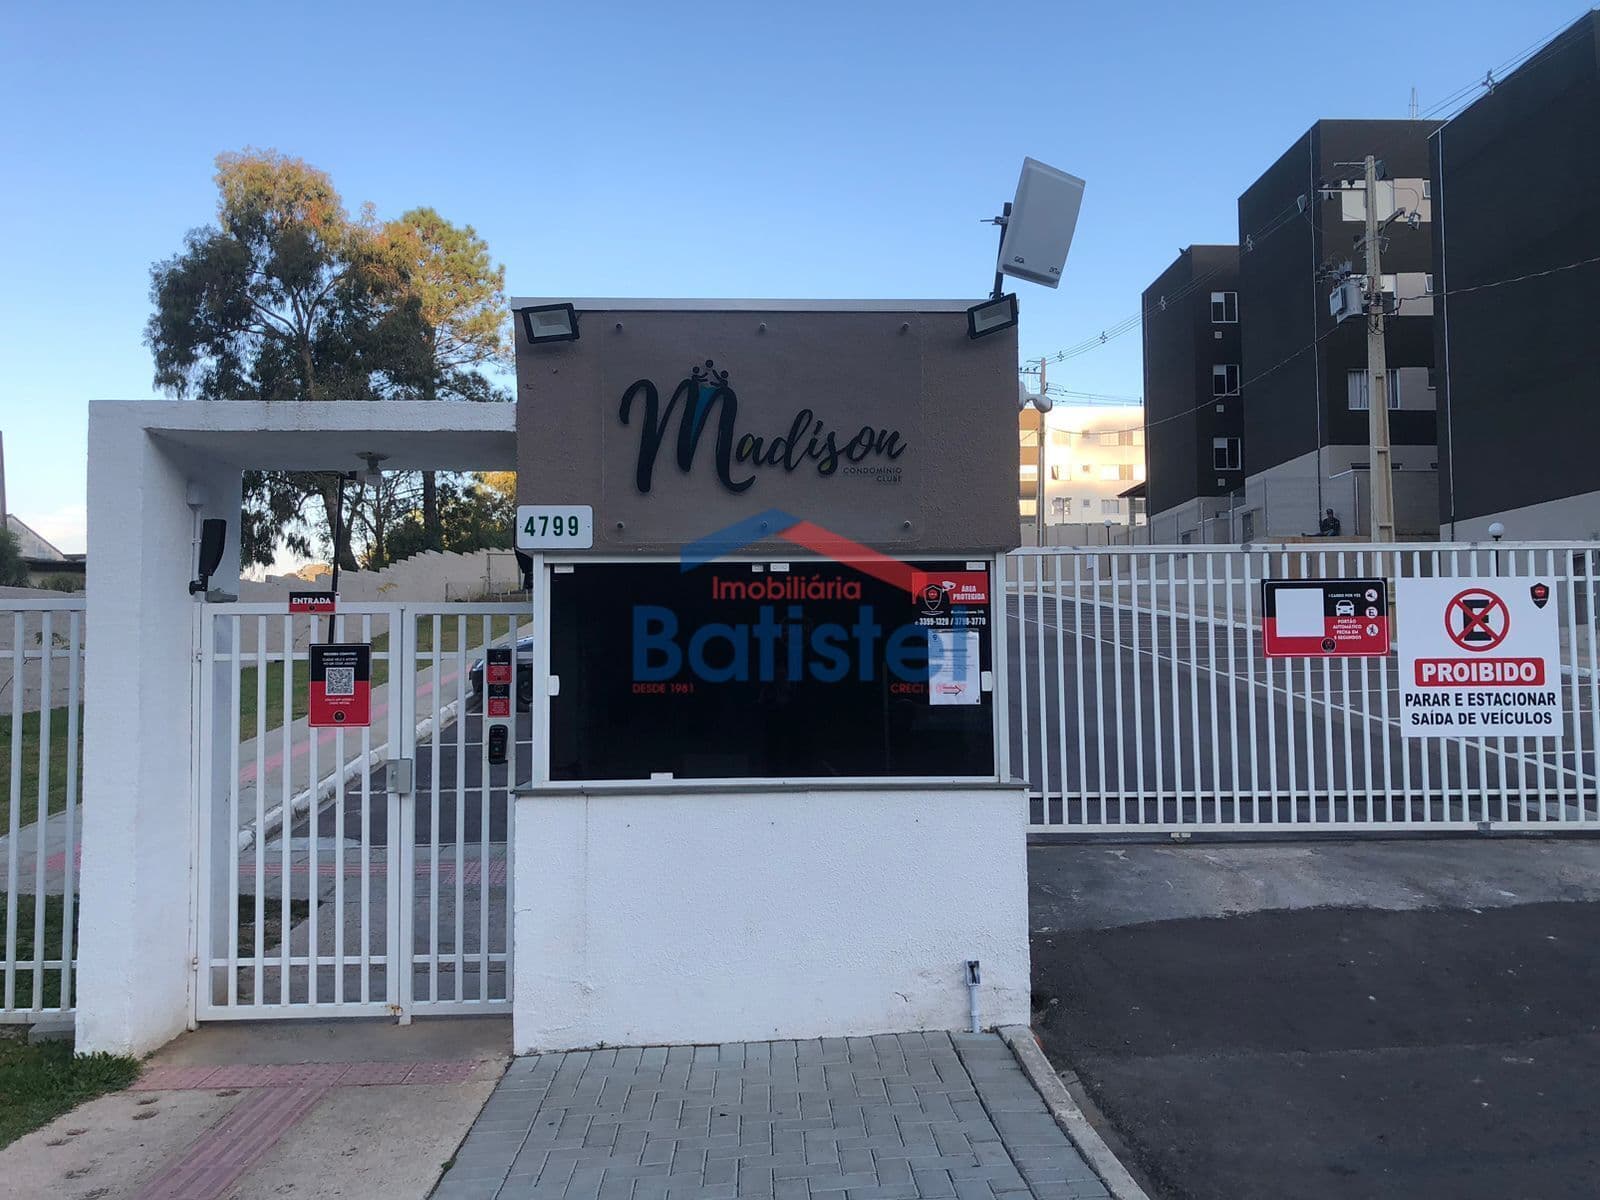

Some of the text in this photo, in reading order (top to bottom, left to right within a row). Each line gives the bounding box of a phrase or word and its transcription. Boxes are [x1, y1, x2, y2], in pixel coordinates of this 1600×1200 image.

[618, 377, 908, 494] Madison
[523, 514, 580, 537] 4799
[292, 597, 332, 605] ENTRADA
[952, 592, 986, 601] PROTEGIDA
[1421, 661, 1537, 683] PROIBIDO
[1405, 691, 1556, 707] PARAR E ESTACIONAR
[1411, 709, 1553, 725] SAÍDA DE VEÍCULOS
